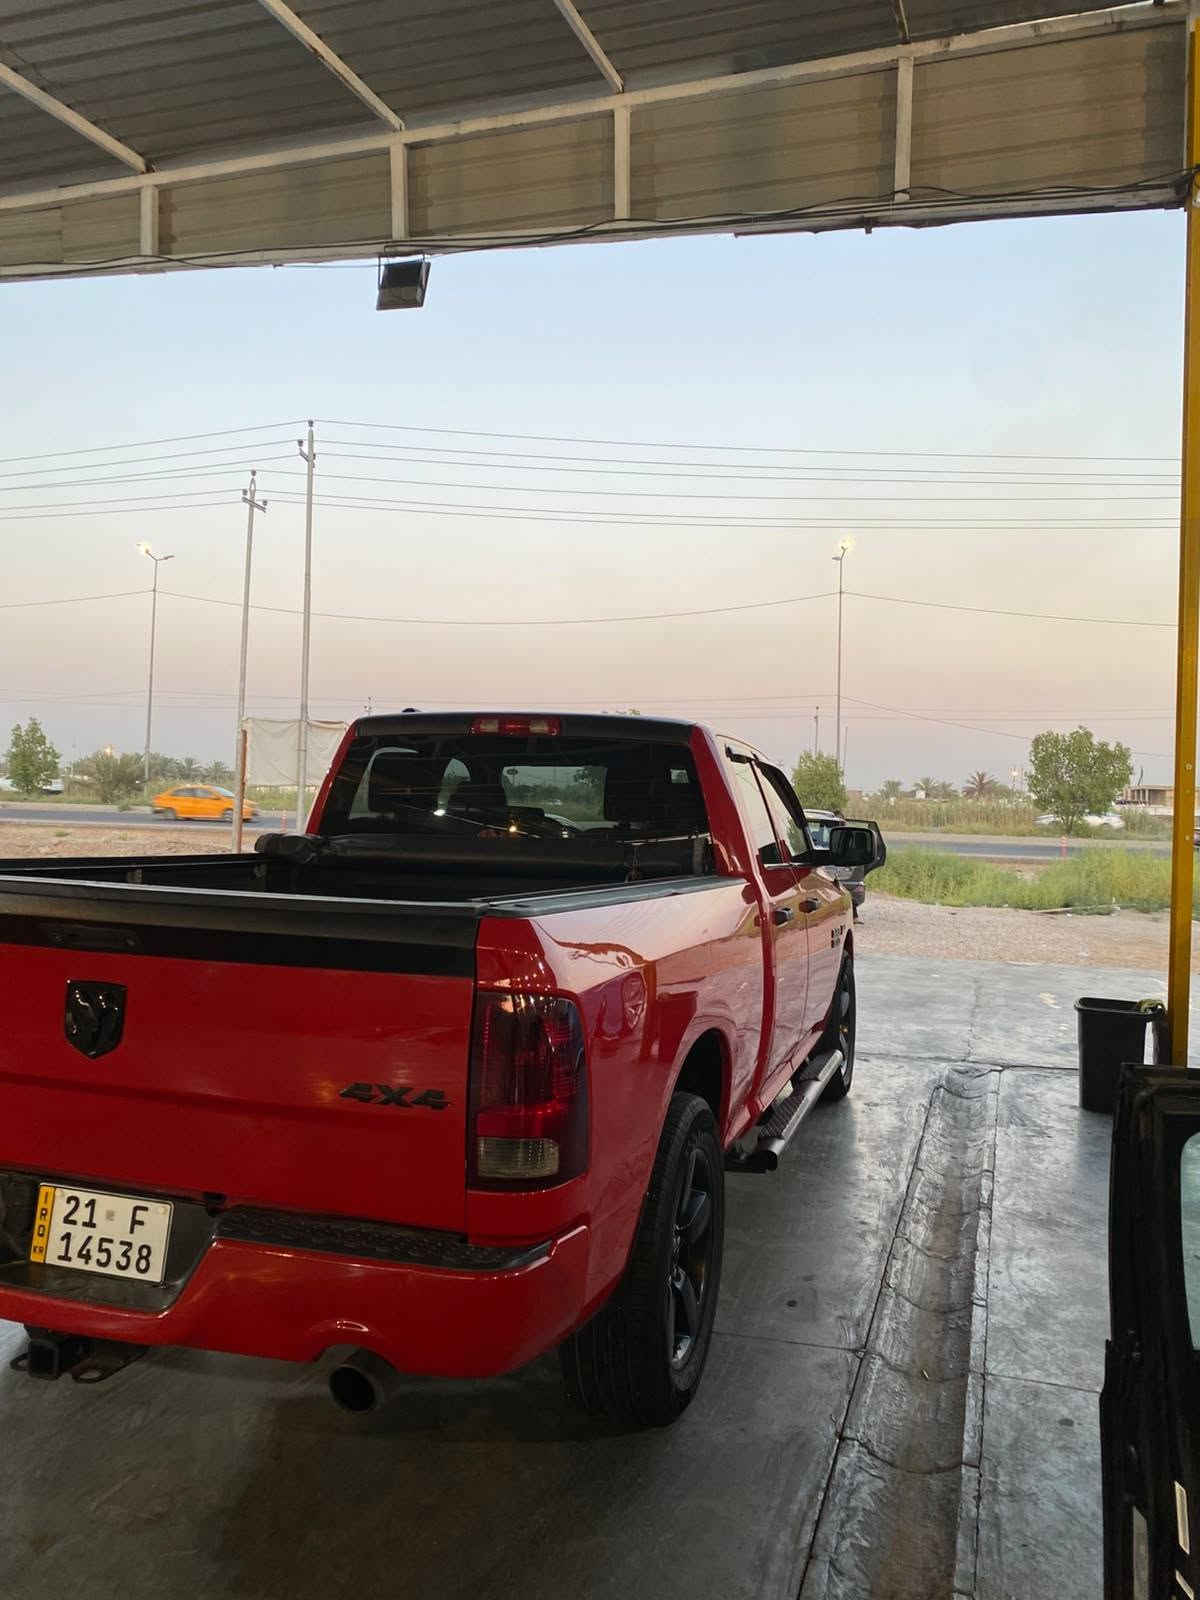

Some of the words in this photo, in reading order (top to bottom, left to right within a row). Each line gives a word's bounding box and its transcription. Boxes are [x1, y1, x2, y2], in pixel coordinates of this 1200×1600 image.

[62, 1195, 97, 1228] 21
[129, 1205, 149, 1234] F
[57, 1232, 152, 1274] 14538
